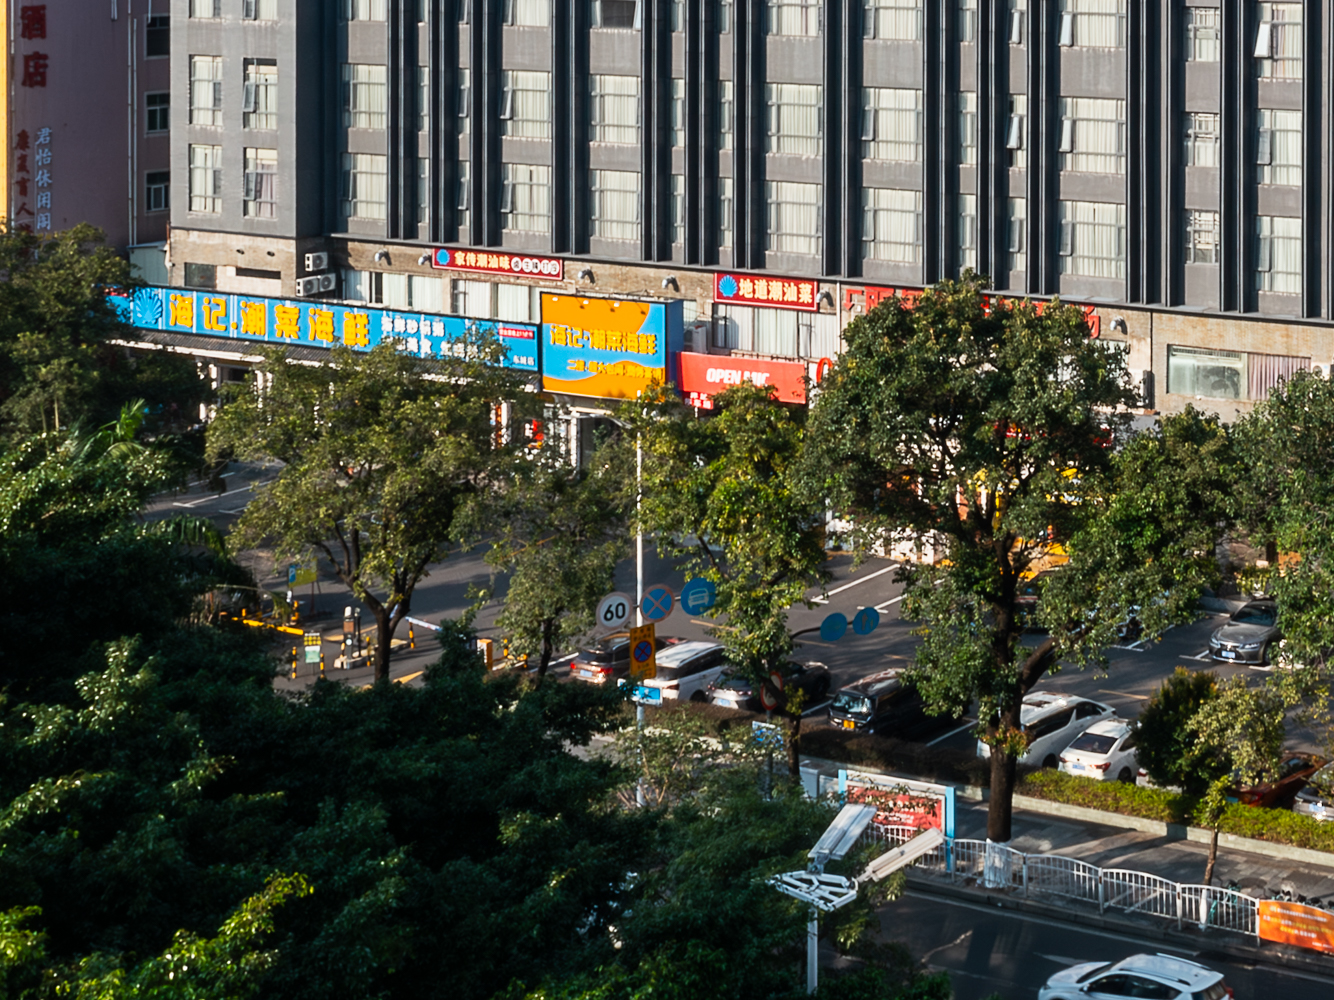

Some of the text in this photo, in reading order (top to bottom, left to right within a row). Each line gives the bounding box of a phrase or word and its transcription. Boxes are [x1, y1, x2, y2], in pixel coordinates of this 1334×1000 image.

[738, 278, 813, 304] 地道潮汕菜
[706, 367, 743, 385] OPEN
[603, 602, 626, 622] 60
